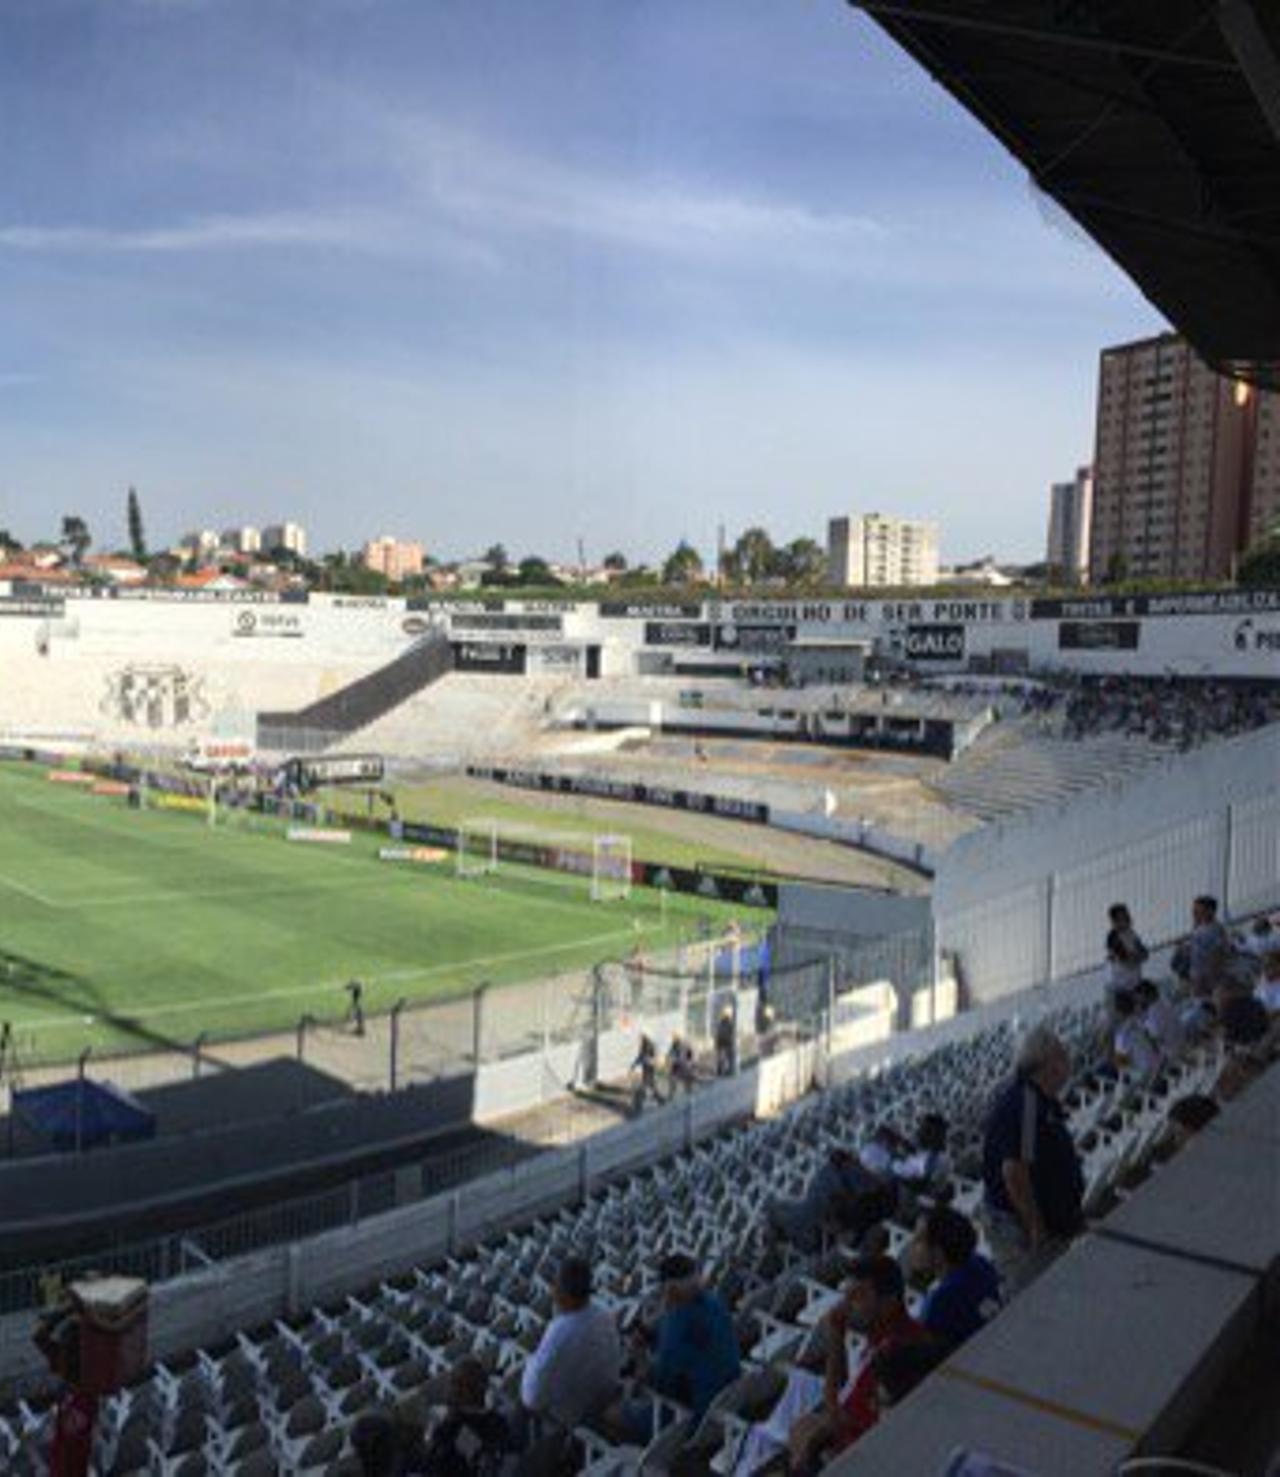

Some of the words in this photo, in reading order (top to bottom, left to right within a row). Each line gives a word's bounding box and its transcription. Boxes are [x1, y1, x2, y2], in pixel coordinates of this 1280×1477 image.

[843, 604, 867, 622] DE
[882, 603, 922, 620] SER
[933, 602, 1003, 620] PONTE
[908, 633, 964, 653] GALO
